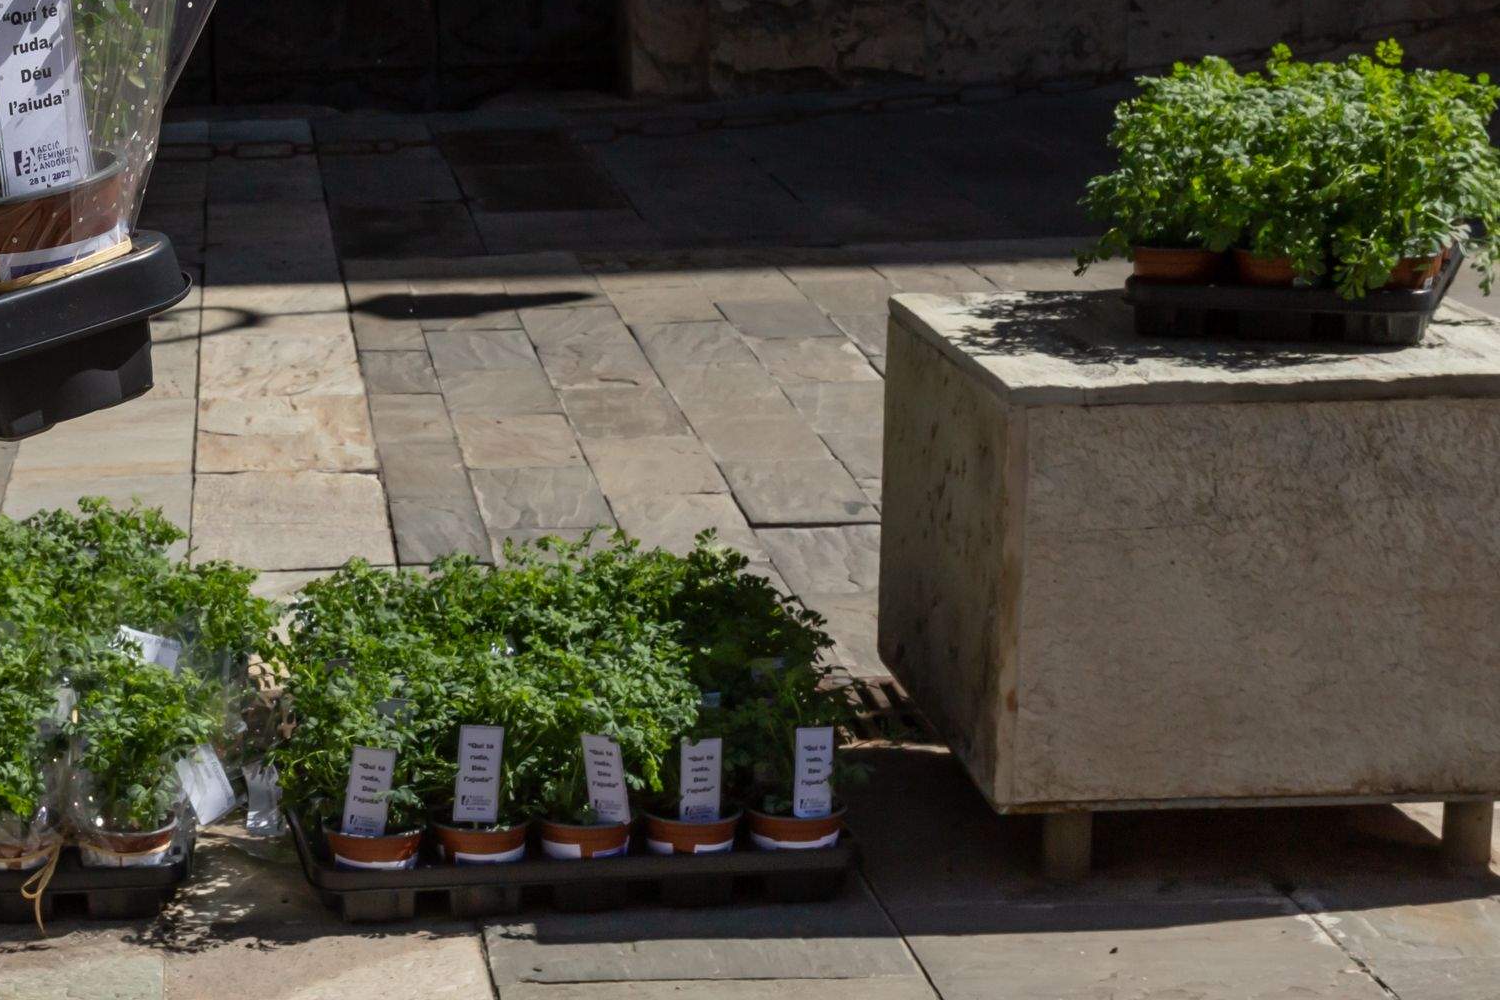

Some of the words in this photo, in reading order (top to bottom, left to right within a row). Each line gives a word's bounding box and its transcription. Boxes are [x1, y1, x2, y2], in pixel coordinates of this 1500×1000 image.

[41, 2, 58, 19] té
[12, 36, 54, 56] ruda,
[20, 66, 52, 84] Déu
[37, 145, 79, 161] FEMINISTA
